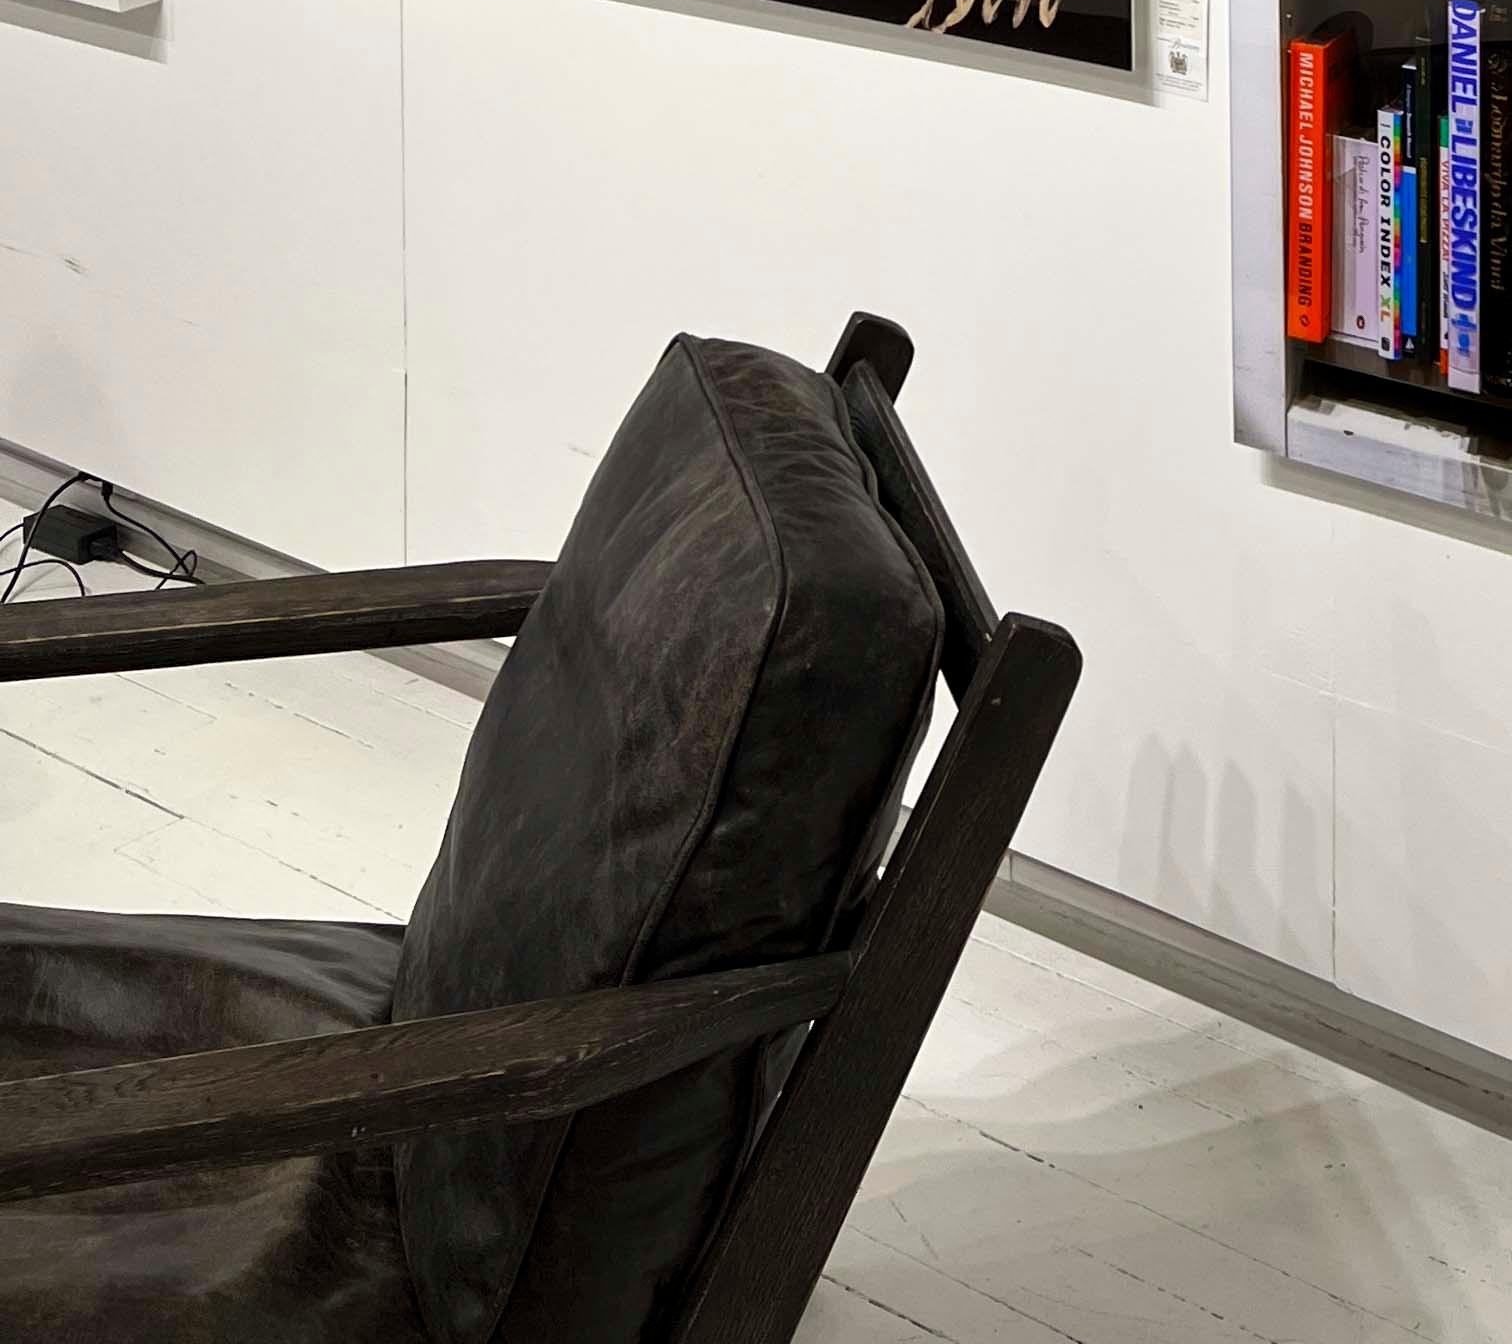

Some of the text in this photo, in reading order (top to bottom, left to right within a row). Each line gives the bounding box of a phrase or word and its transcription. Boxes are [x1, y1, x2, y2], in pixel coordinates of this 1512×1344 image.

[1298, 52, 1315, 306] MICHAEL JOHNSON BRANDING
[1380, 135, 1391, 321] COLOR INDEX XL
[1450, 0, 1479, 313] DANIEL LIBESKIND
